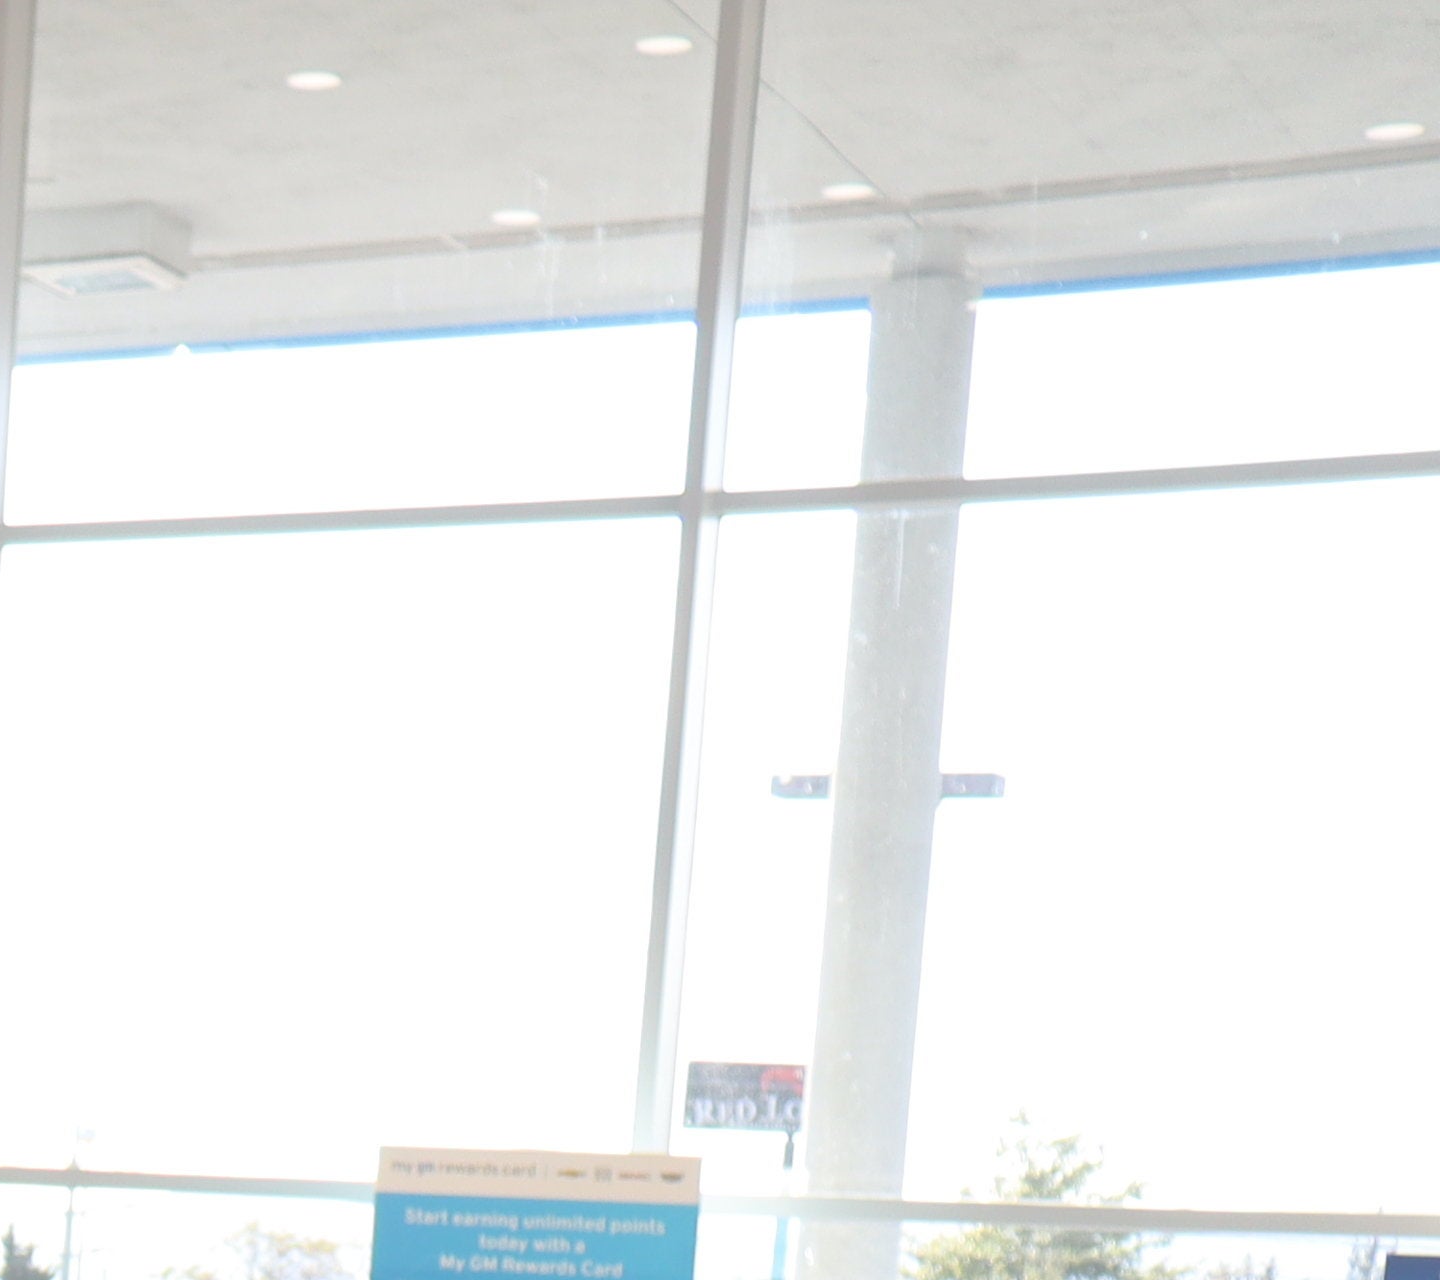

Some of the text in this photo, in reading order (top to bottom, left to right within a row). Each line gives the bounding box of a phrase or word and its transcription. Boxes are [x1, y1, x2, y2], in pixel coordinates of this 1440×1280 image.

[438, 1161, 498, 1178] rewards
[501, 1163, 537, 1178] card
[406, 1208, 666, 1236] Start earning unlimited points
[480, 1234, 586, 1254] today with a
[440, 1254, 623, 1278] My GM Rewards Card
